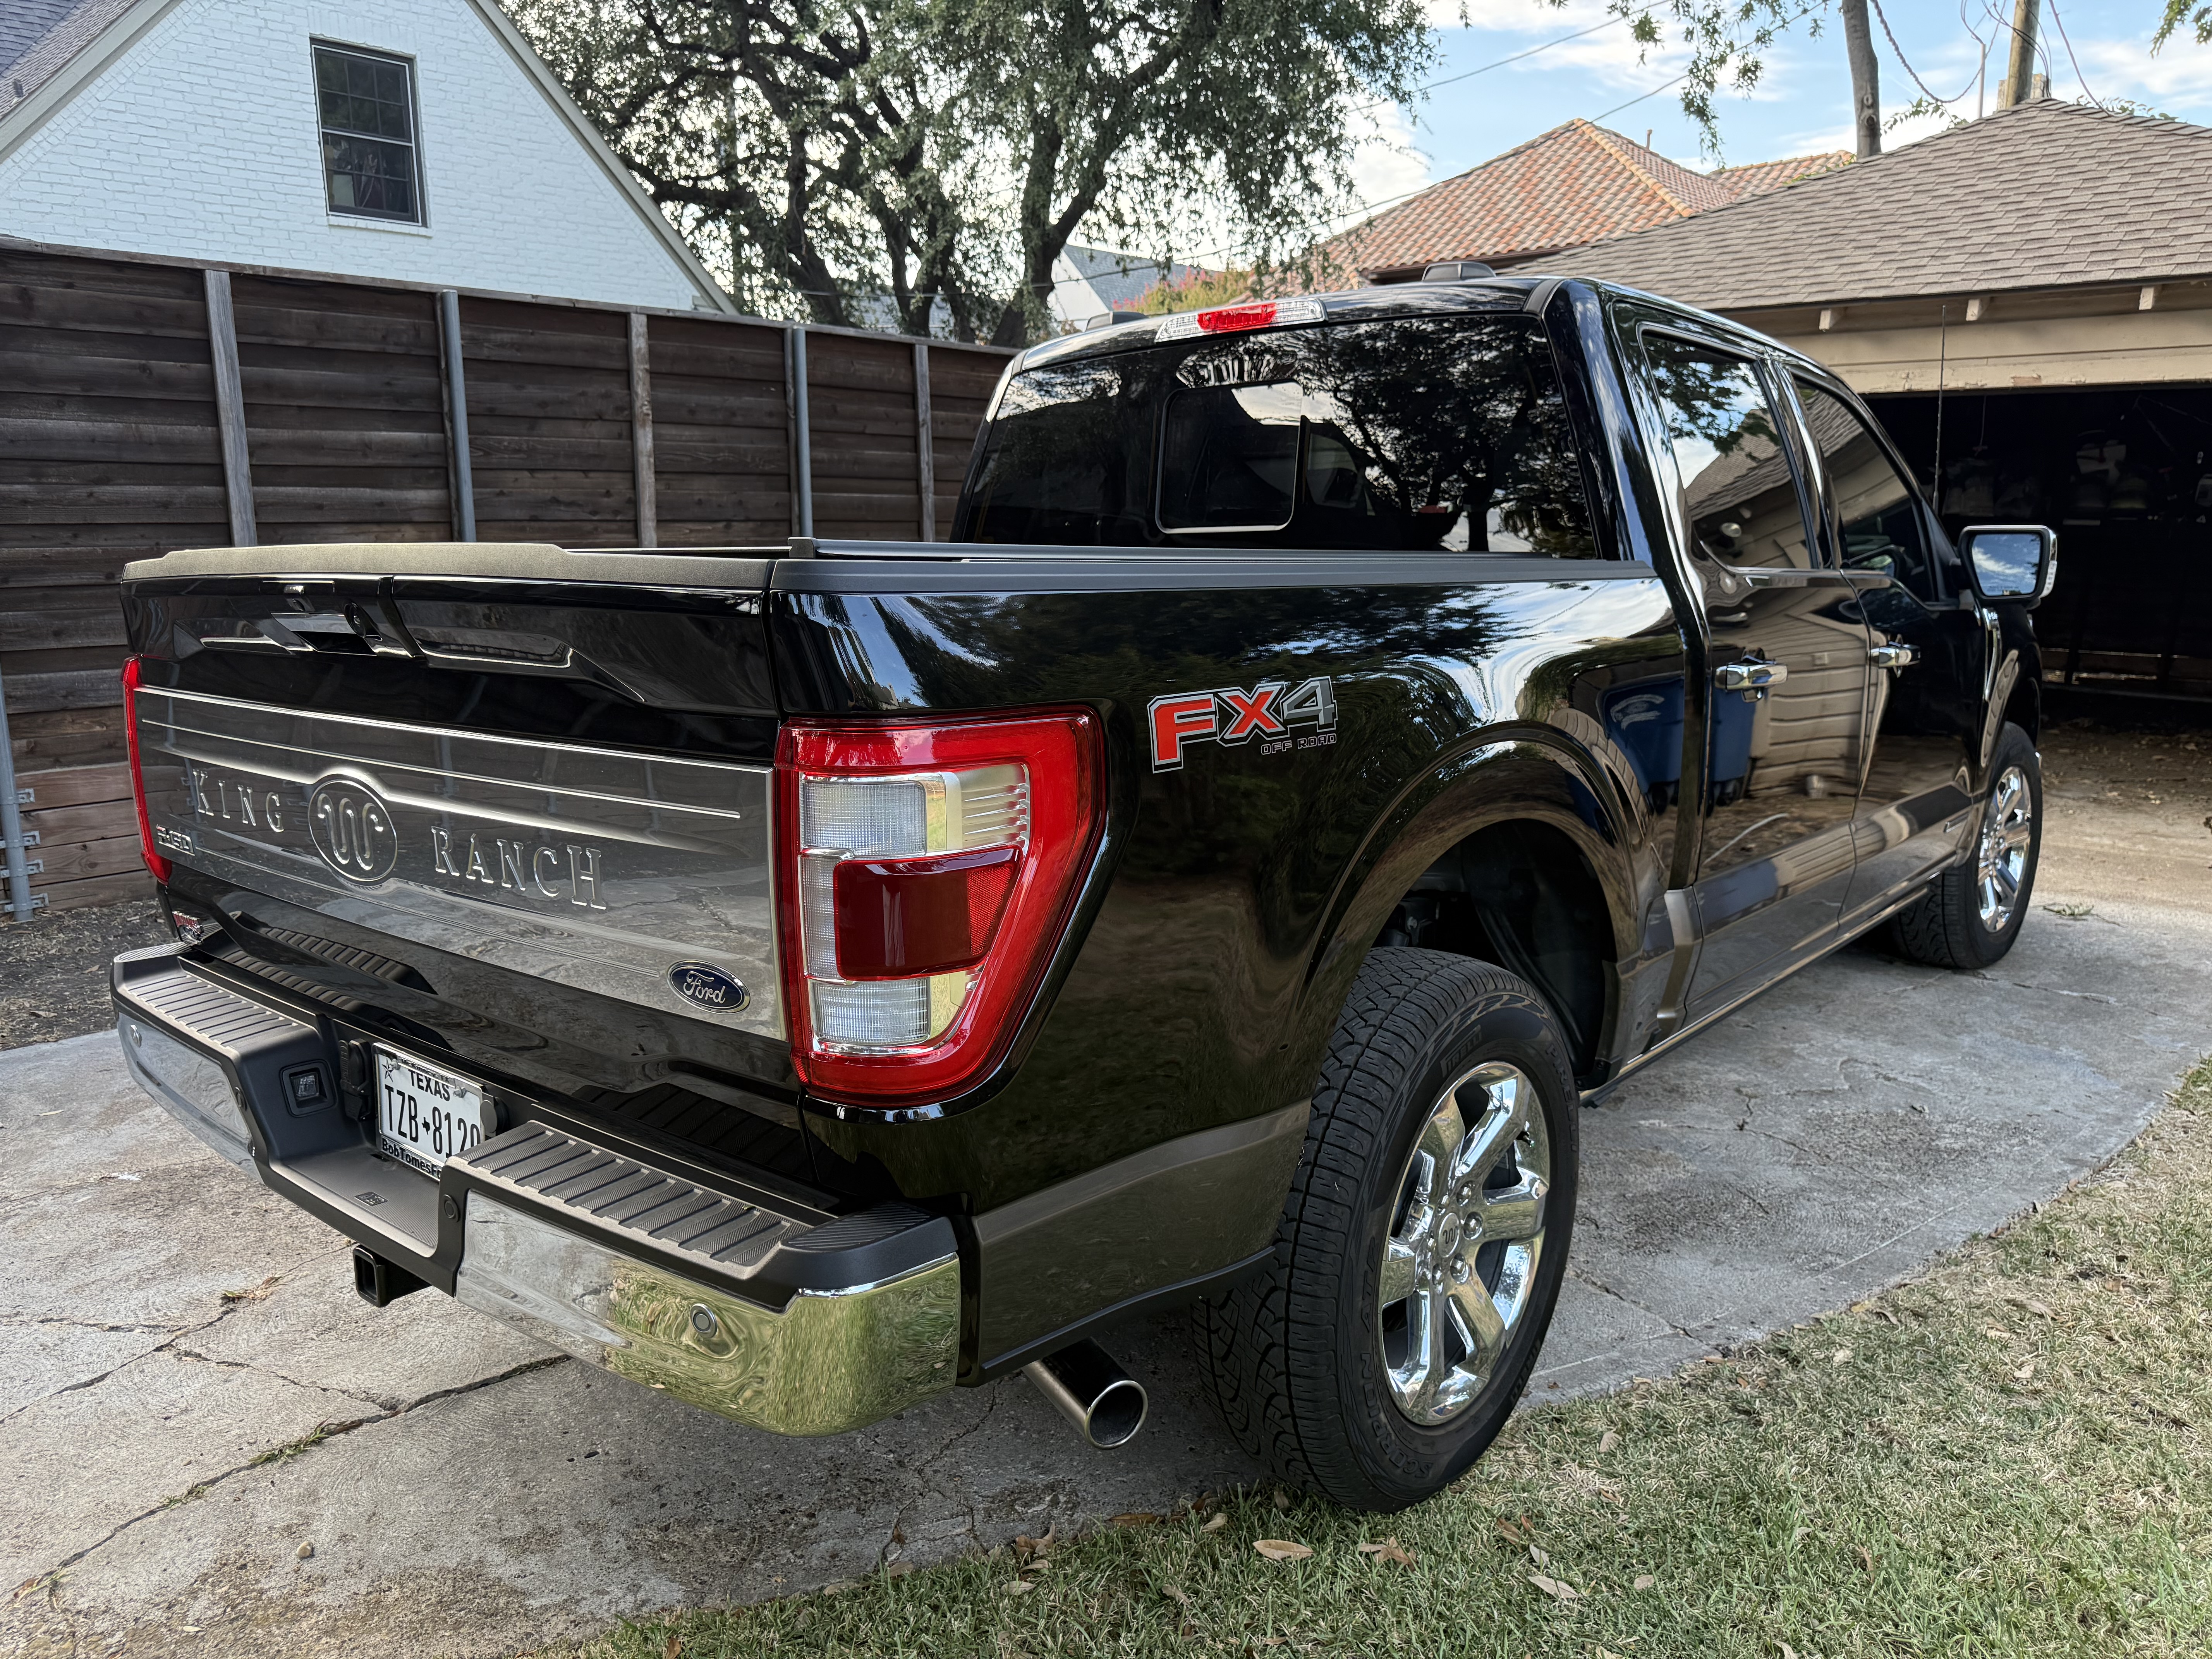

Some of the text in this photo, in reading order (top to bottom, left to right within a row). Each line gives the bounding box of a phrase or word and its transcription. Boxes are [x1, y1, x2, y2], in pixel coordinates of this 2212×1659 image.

[1147, 676, 1338, 774] FX4
[1261, 733, 1337, 755] OFF ROAD
[192, 768, 607, 910] KING RANCH
[683, 971, 726, 1004] Ford
[385, 1085, 419, 1143] TZB
[408, 1069, 450, 1102] TEXAS
[1360, 1352, 1434, 1479] SCORPION
